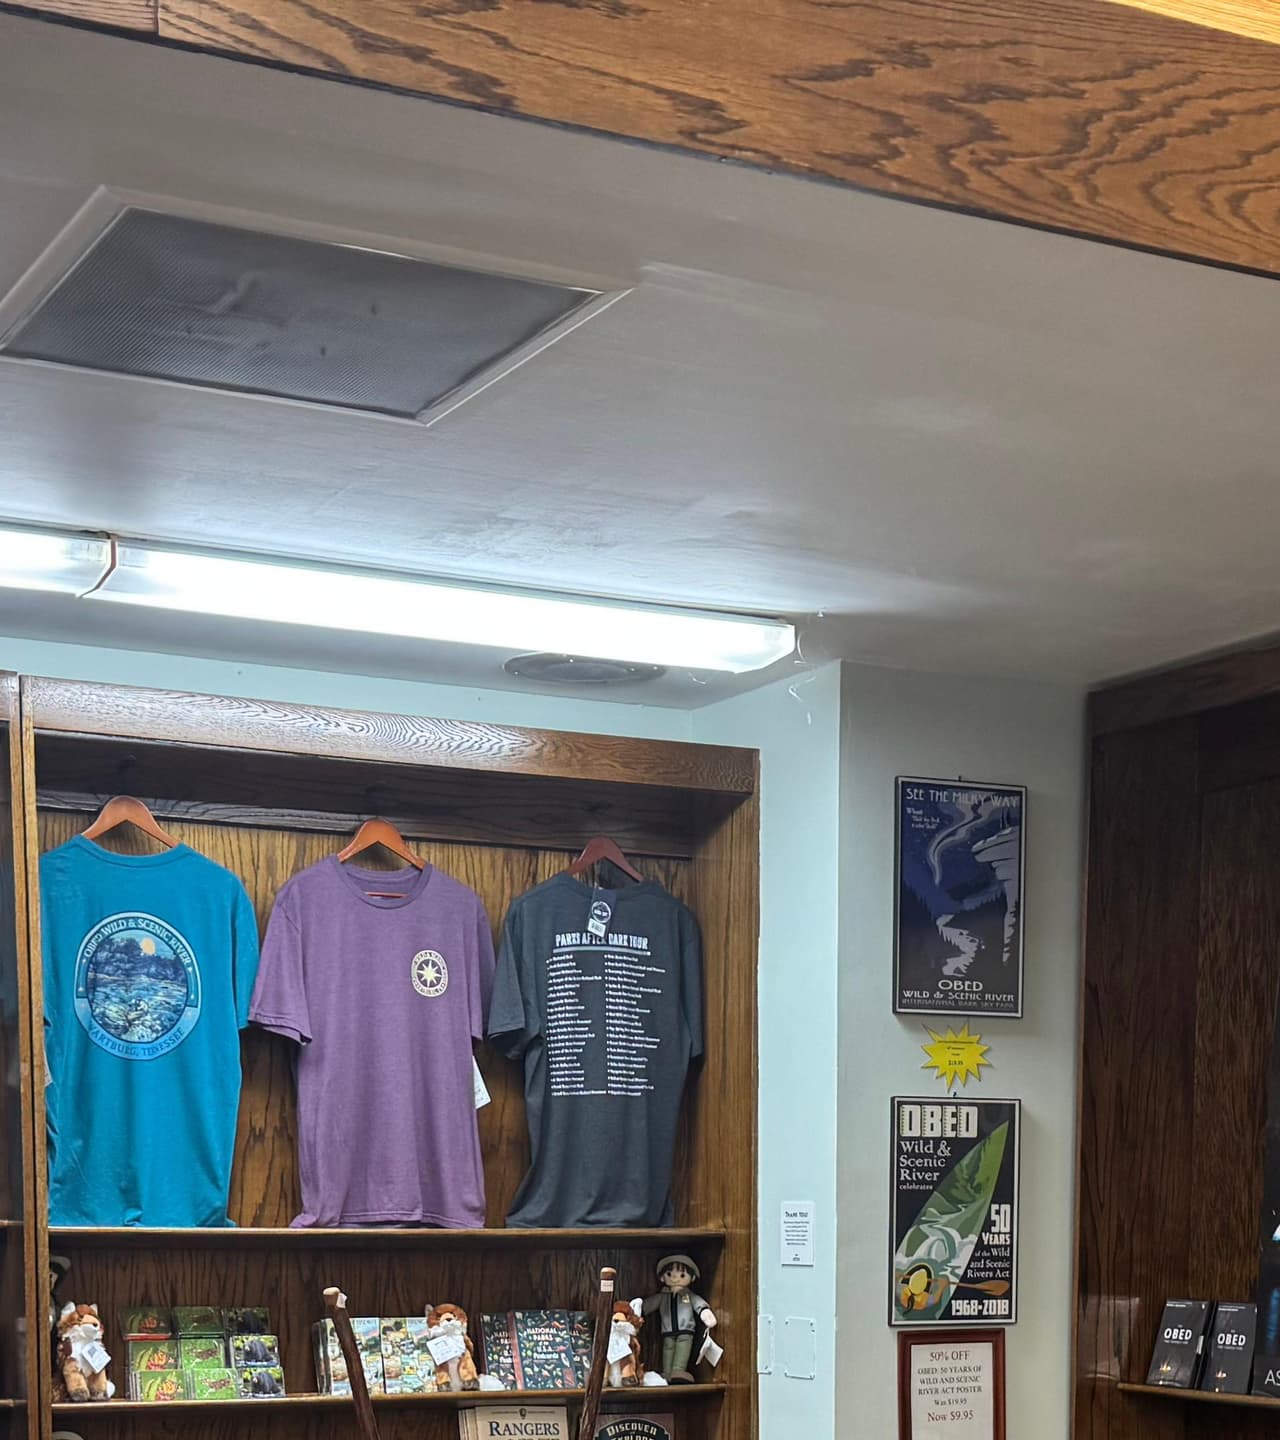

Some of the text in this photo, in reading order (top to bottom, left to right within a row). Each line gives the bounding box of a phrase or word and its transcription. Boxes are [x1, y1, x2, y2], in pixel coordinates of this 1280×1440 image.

[102, 918, 192, 967] WILD & SCENIC RIVER
[555, 933, 648, 950] PARKS DARK TOUR
[938, 980, 983, 991] OBED
[900, 1105, 978, 1138] OBED
[900, 1141, 951, 1156] Wild &
[900, 1155, 945, 1167] Scenic
[900, 1169, 939, 1181] River
[990, 1204, 1010, 1233] 50
[982, 1233, 1010, 1245] YEARS
[991, 1248, 1010, 1257] Wild
[970, 1259, 1010, 1268] and Scenic
[968, 1269, 993, 1277] Rivers
[1164, 1328, 1192, 1340] OBED
[1217, 1333, 1246, 1345] OBED
[951, 1351, 970, 1360] OFF
[928, 1410, 974, 1422] Now $9.95
[489, 1421, 560, 1437] RANGERS
[606, 1423, 657, 1437] DISCOVER
